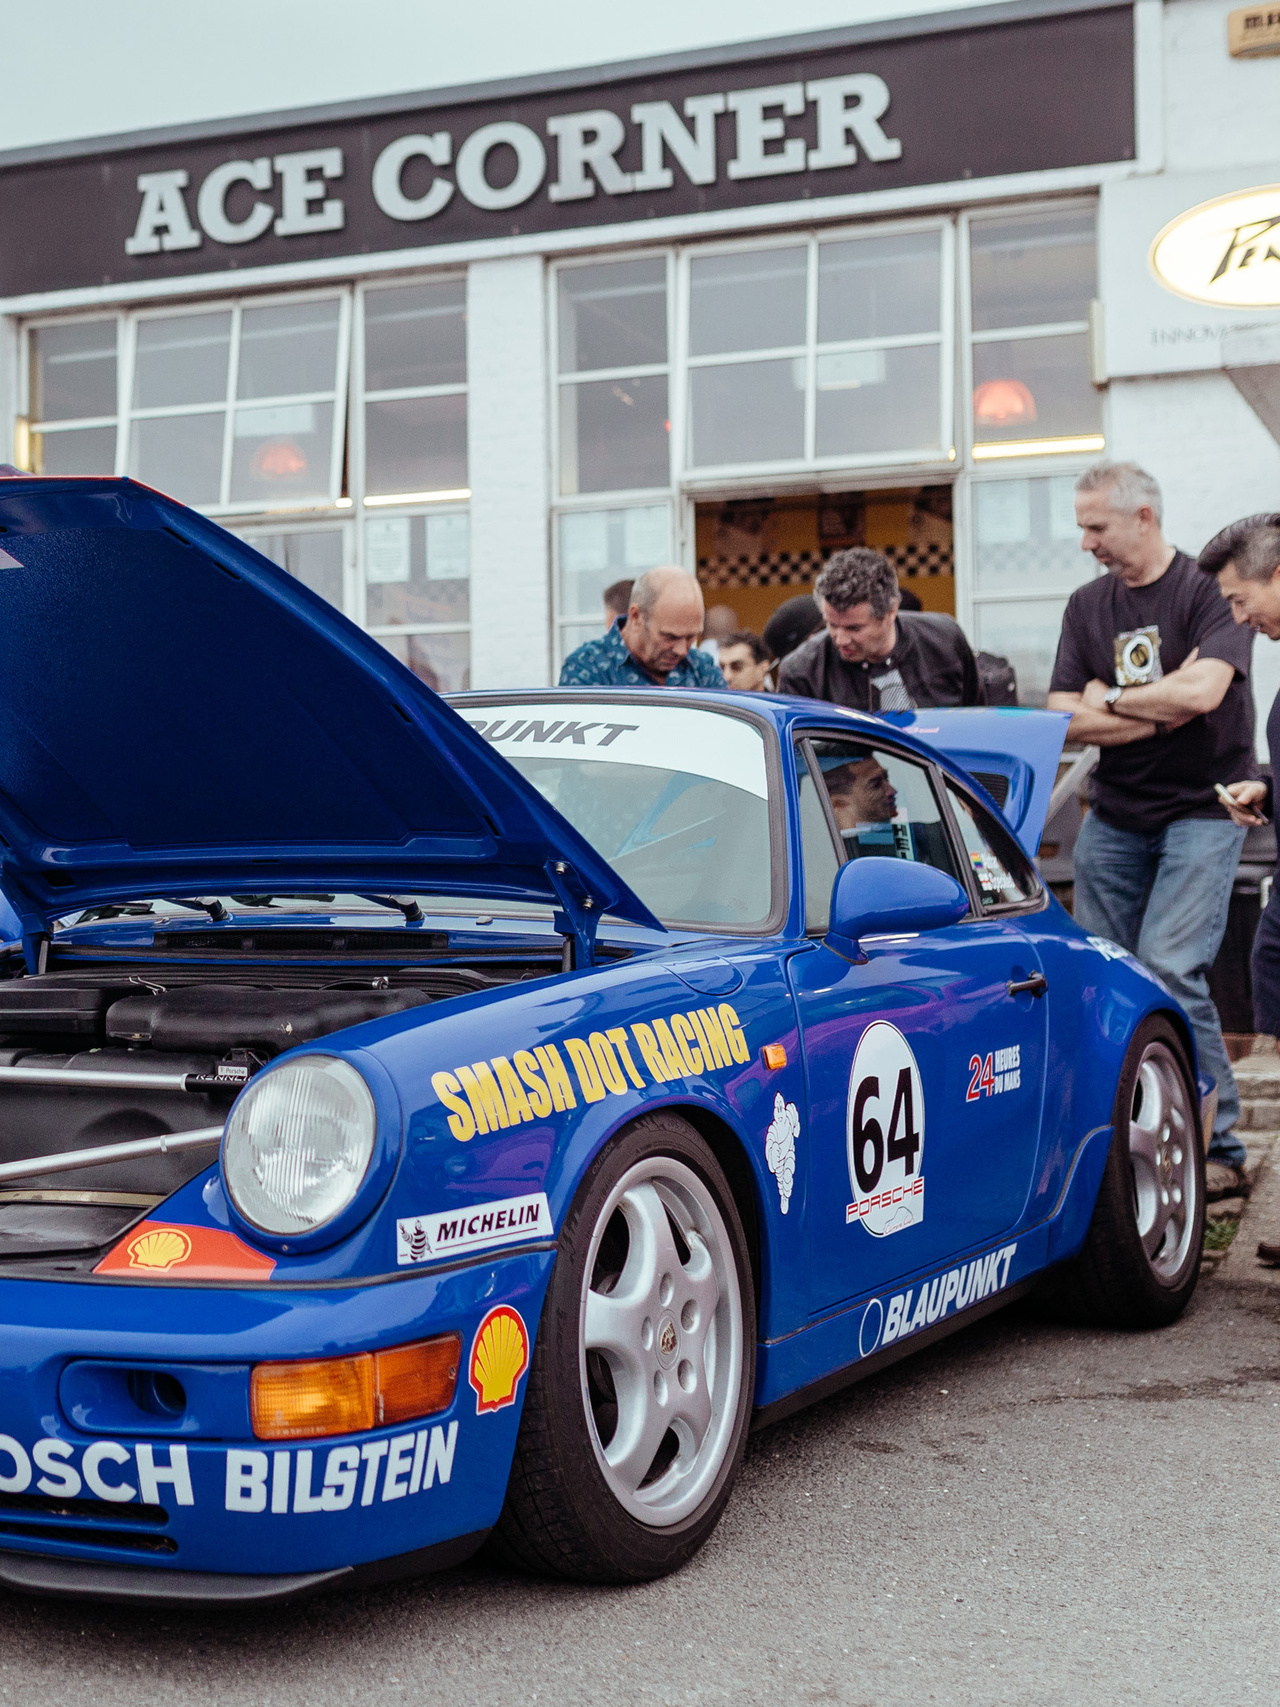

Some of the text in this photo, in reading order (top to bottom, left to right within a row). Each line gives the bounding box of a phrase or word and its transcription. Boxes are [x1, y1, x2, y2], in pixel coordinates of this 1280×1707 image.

[125, 73, 903, 256] ACE CORNER
[430, 1003, 751, 1142] SMASH DOT RACING
[966, 1044, 1020, 1103] 24 HEURES
[1004, 1068, 1021, 1092] MANS
[852, 1066, 920, 1194] 64
[436, 1203, 540, 1242] MICHELIN
[847, 1178, 923, 1222] PORSCHE
[881, 1242, 1018, 1346] BLAUPUNKT
[224, 1420, 459, 1514] BILSTEIN
